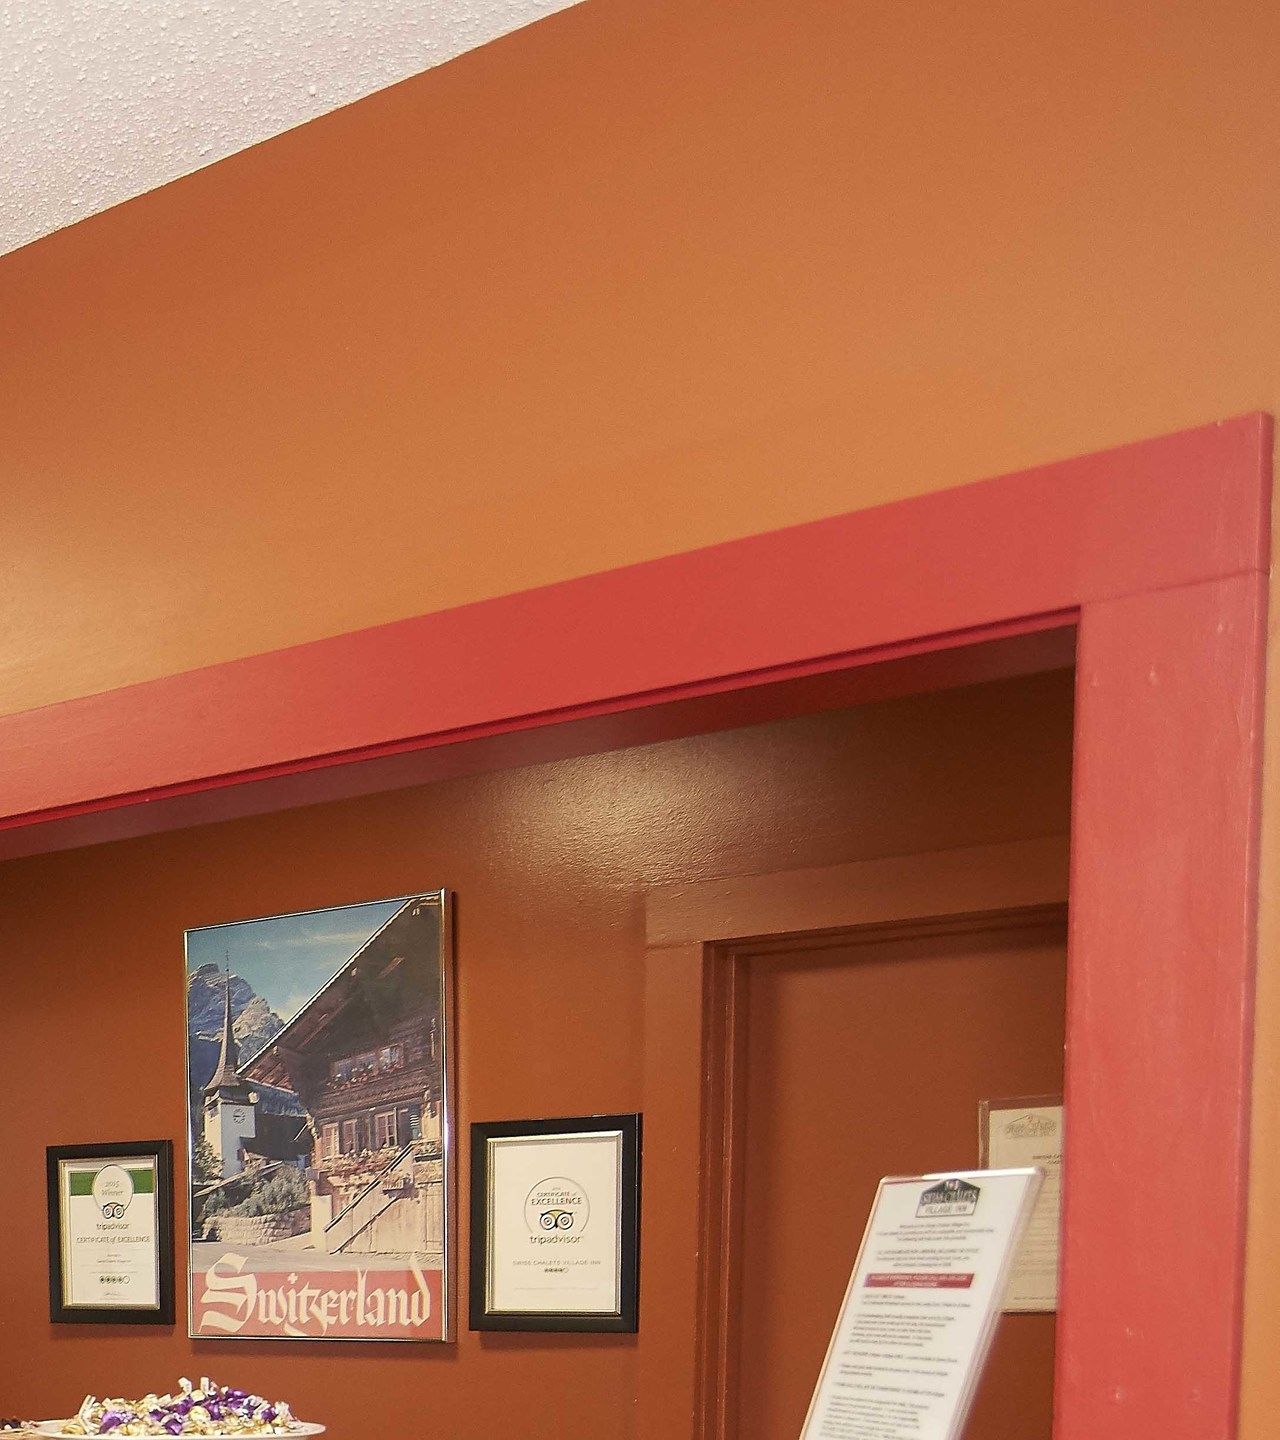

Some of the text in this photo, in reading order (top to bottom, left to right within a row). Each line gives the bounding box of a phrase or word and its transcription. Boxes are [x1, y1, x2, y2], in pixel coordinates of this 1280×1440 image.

[531, 1197, 582, 1206] EXCELLENCE
[530, 1235, 581, 1245] tripadvisor
[197, 1252, 431, 1336] Switzerland
